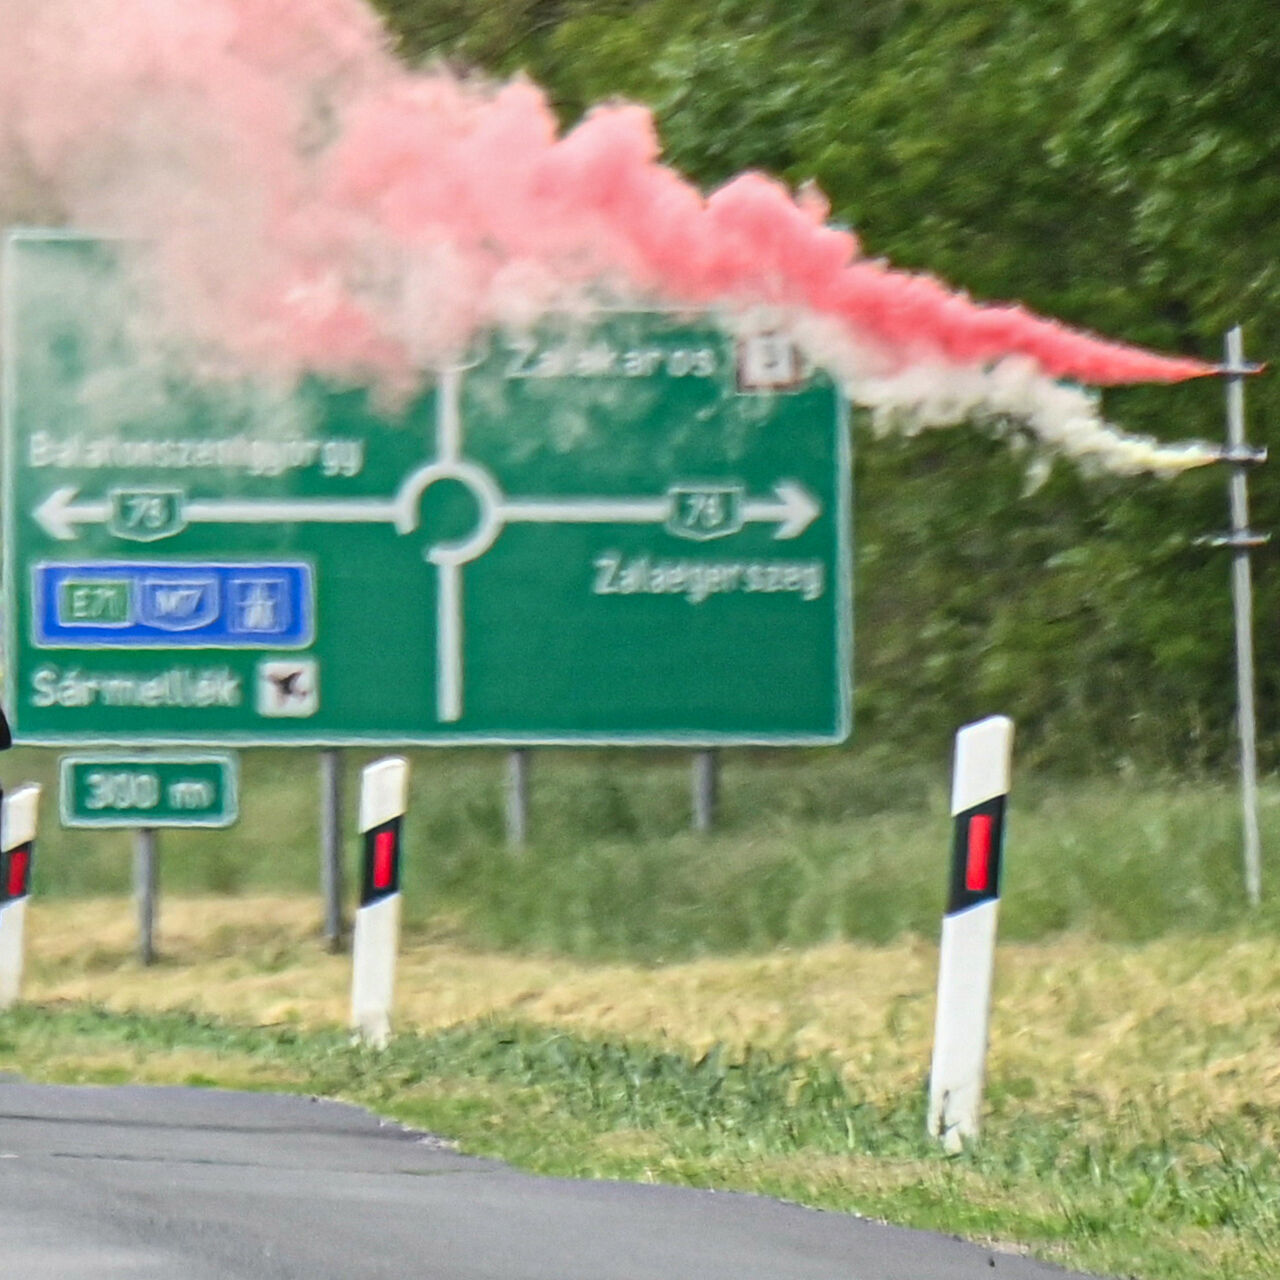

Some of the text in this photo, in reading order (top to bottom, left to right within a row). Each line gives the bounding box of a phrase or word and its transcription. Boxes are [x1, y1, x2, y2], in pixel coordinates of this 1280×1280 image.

[593, 551, 824, 604] Zalaegerszeg
[154, 588, 204, 619] M7
[32, 666, 241, 708] Sármellék
[85, 772, 215, 811] 300 m
